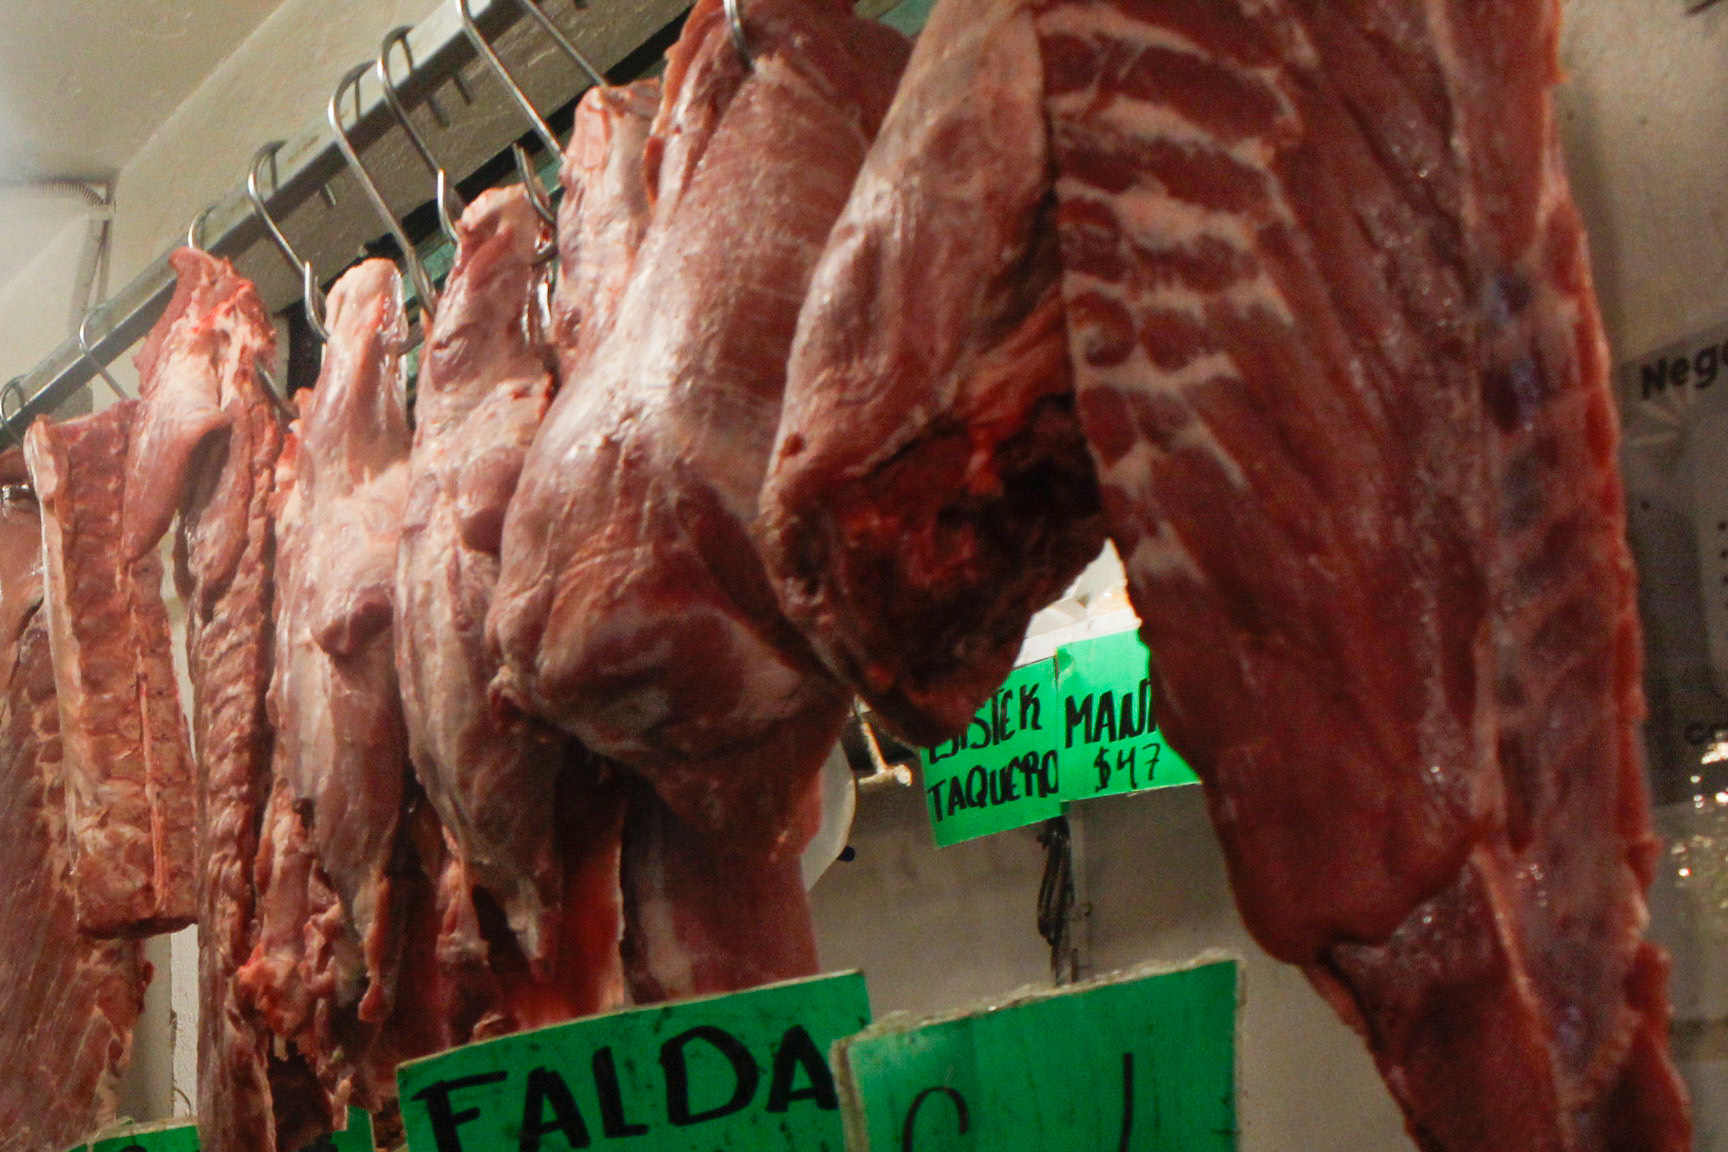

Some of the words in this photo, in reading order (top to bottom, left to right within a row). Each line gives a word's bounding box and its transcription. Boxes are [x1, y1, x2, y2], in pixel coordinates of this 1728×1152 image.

[1641, 338, 1728, 400] Neg
[927, 750, 1059, 822] TAQUERO
[1094, 743, 1161, 793] $47
